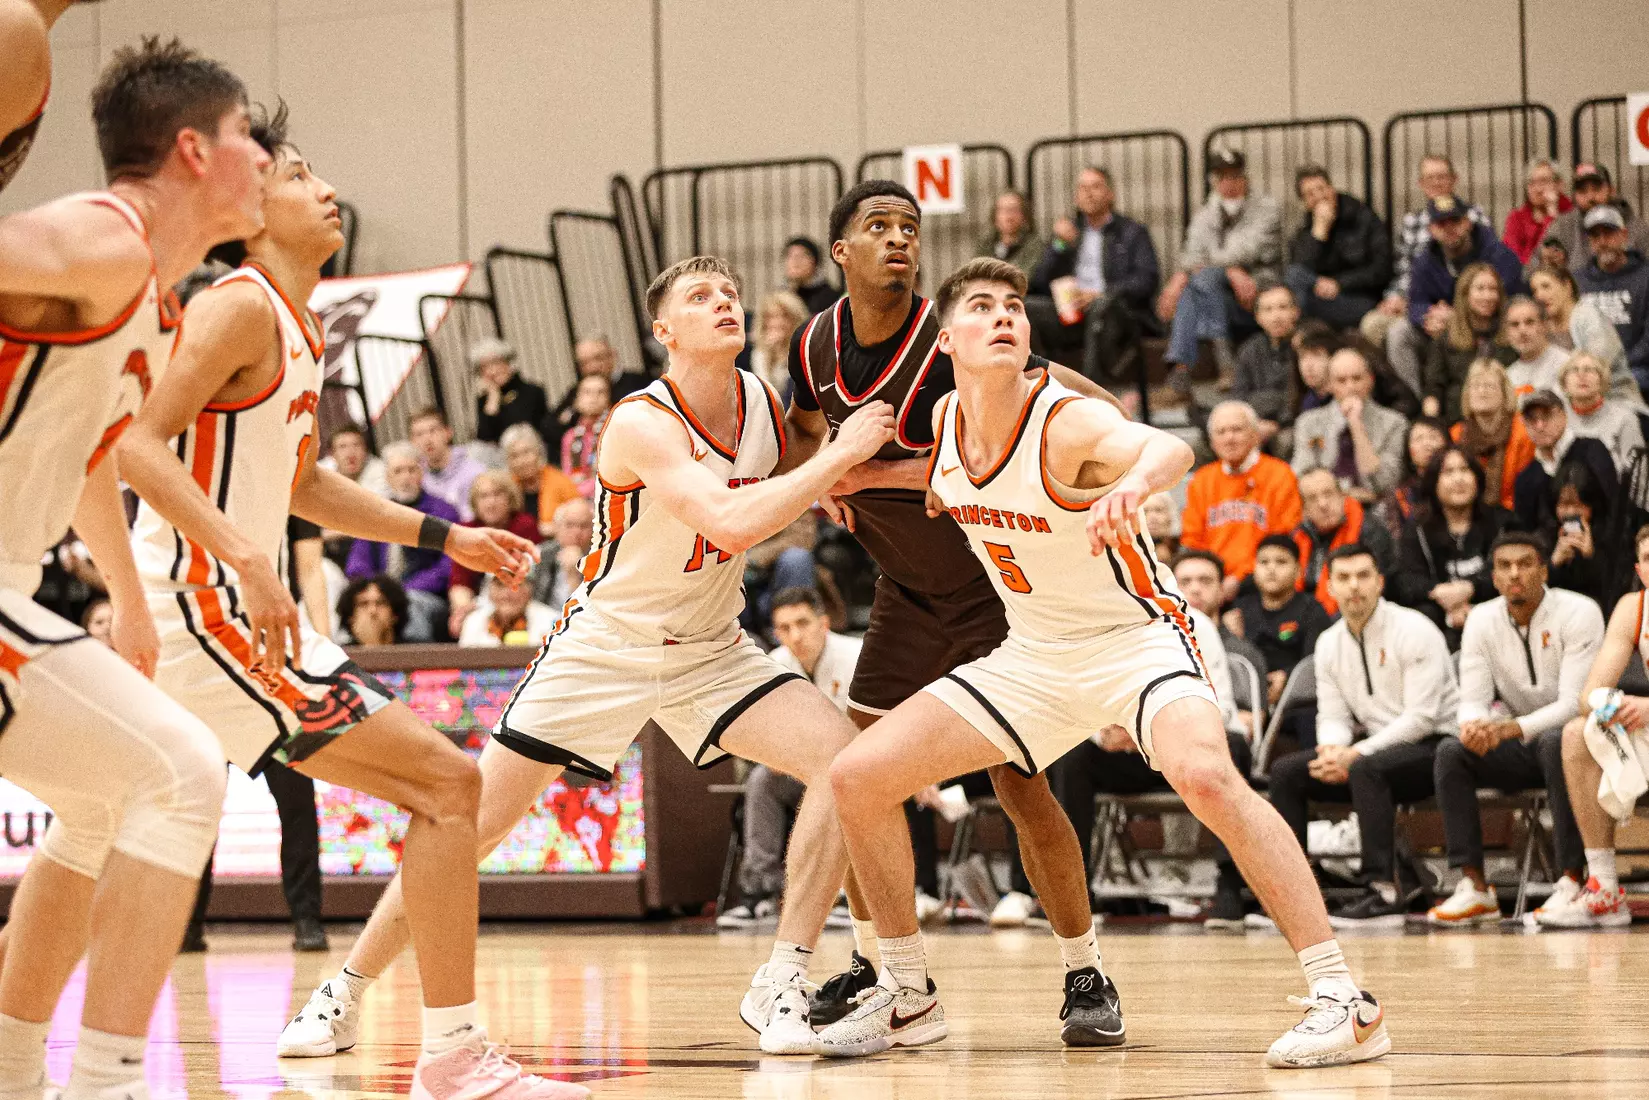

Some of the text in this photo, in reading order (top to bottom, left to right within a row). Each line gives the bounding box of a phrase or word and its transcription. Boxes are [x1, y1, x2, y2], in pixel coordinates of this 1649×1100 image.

[917, 157, 950, 201] N
[949, 503, 1053, 534] RINCETON
[981, 540, 1033, 594] 5
